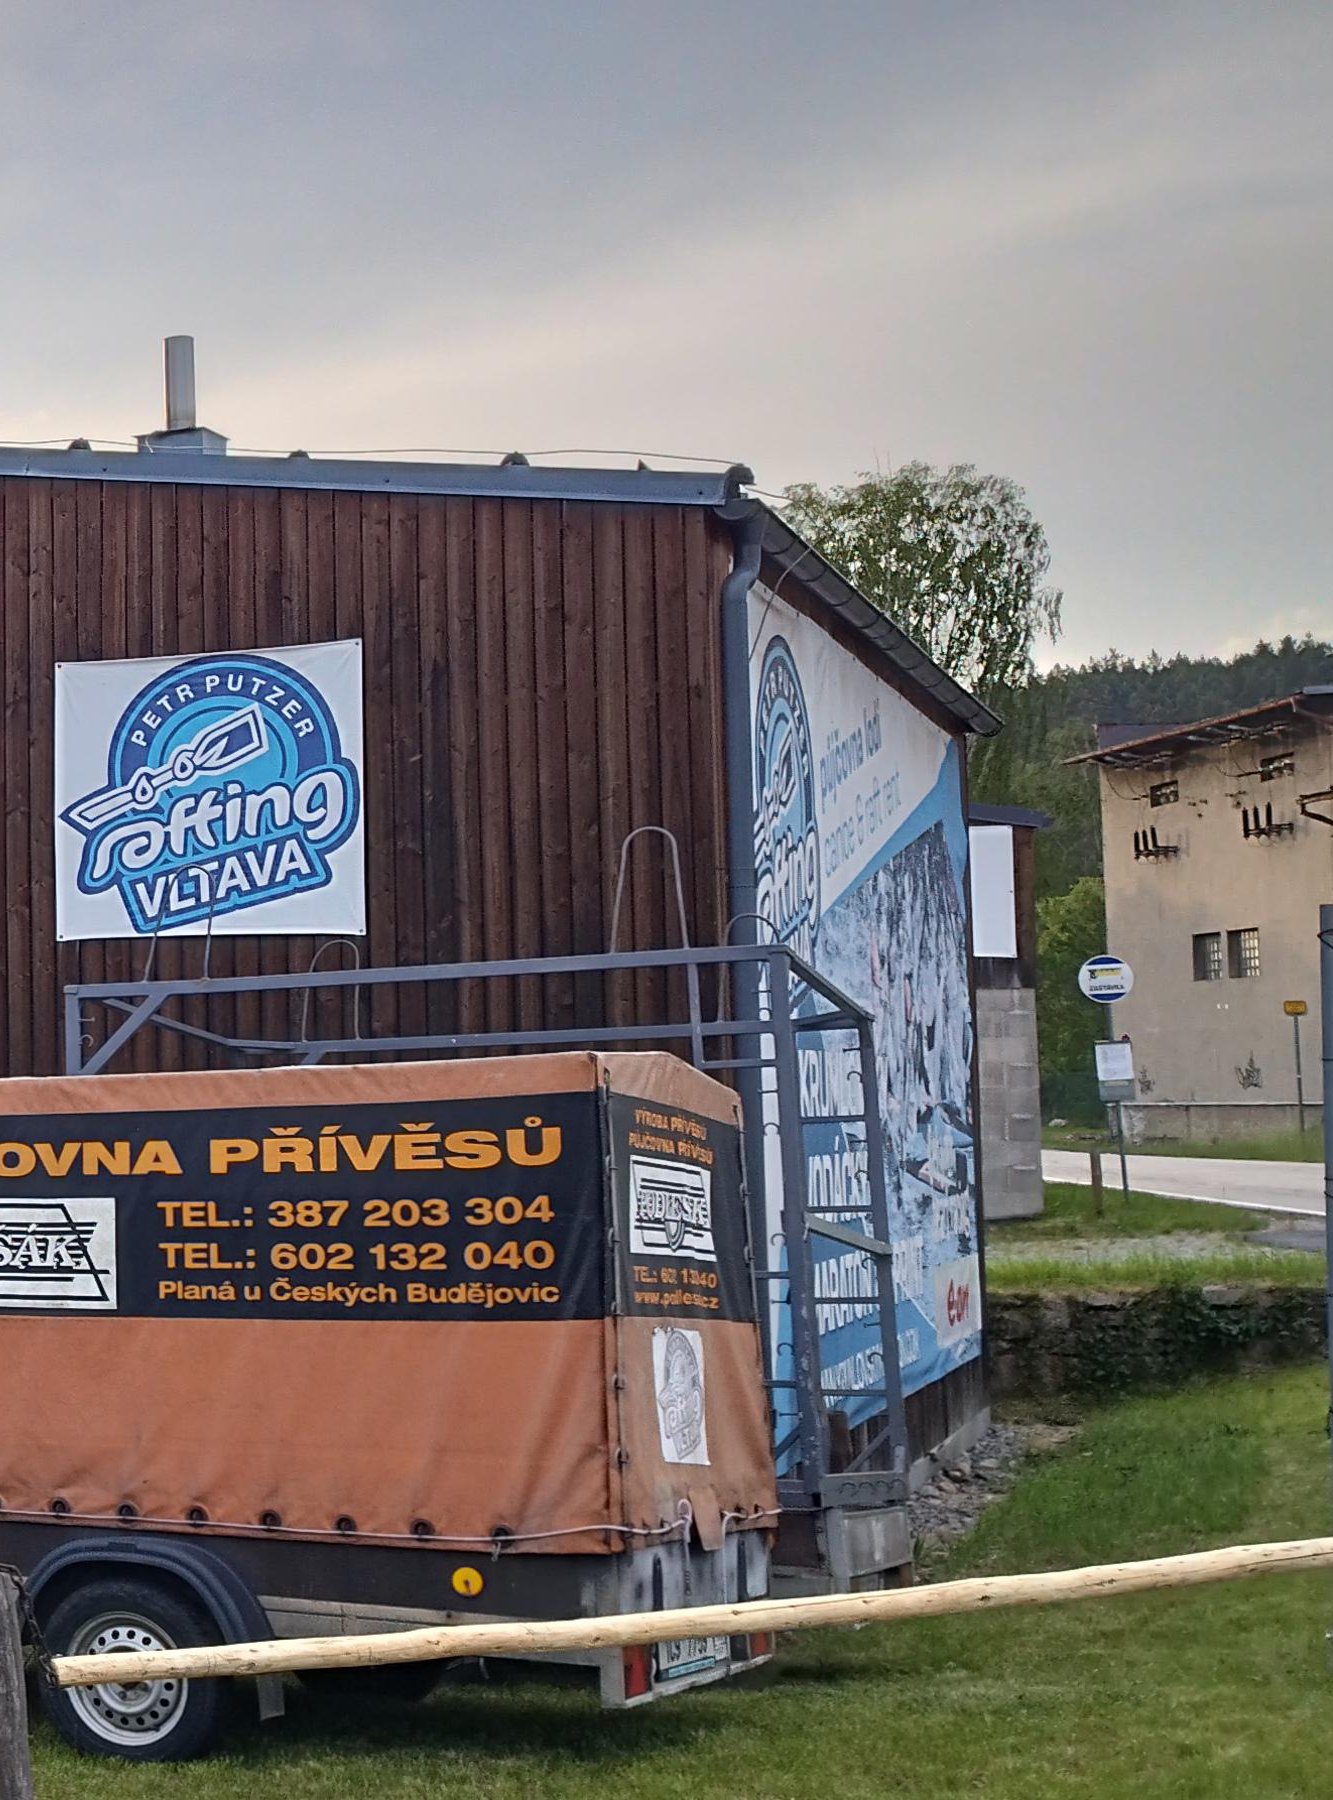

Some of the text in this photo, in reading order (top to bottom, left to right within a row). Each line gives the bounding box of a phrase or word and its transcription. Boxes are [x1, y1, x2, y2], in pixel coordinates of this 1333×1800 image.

[130, 673, 316, 747] PETR PUTZER
[92, 771, 345, 879] rafting
[824, 816, 855, 878] canoe
[135, 839, 312, 919] VLTAVA
[210, 1115, 562, 1175] PŘÍVĚSŮ
[157, 1195, 555, 1228] TEL.: 387 203 304
[159, 1240, 555, 1271] TEL.: 602 132 040
[158, 1277, 559, 1307] Planá u Českých Budějovic
